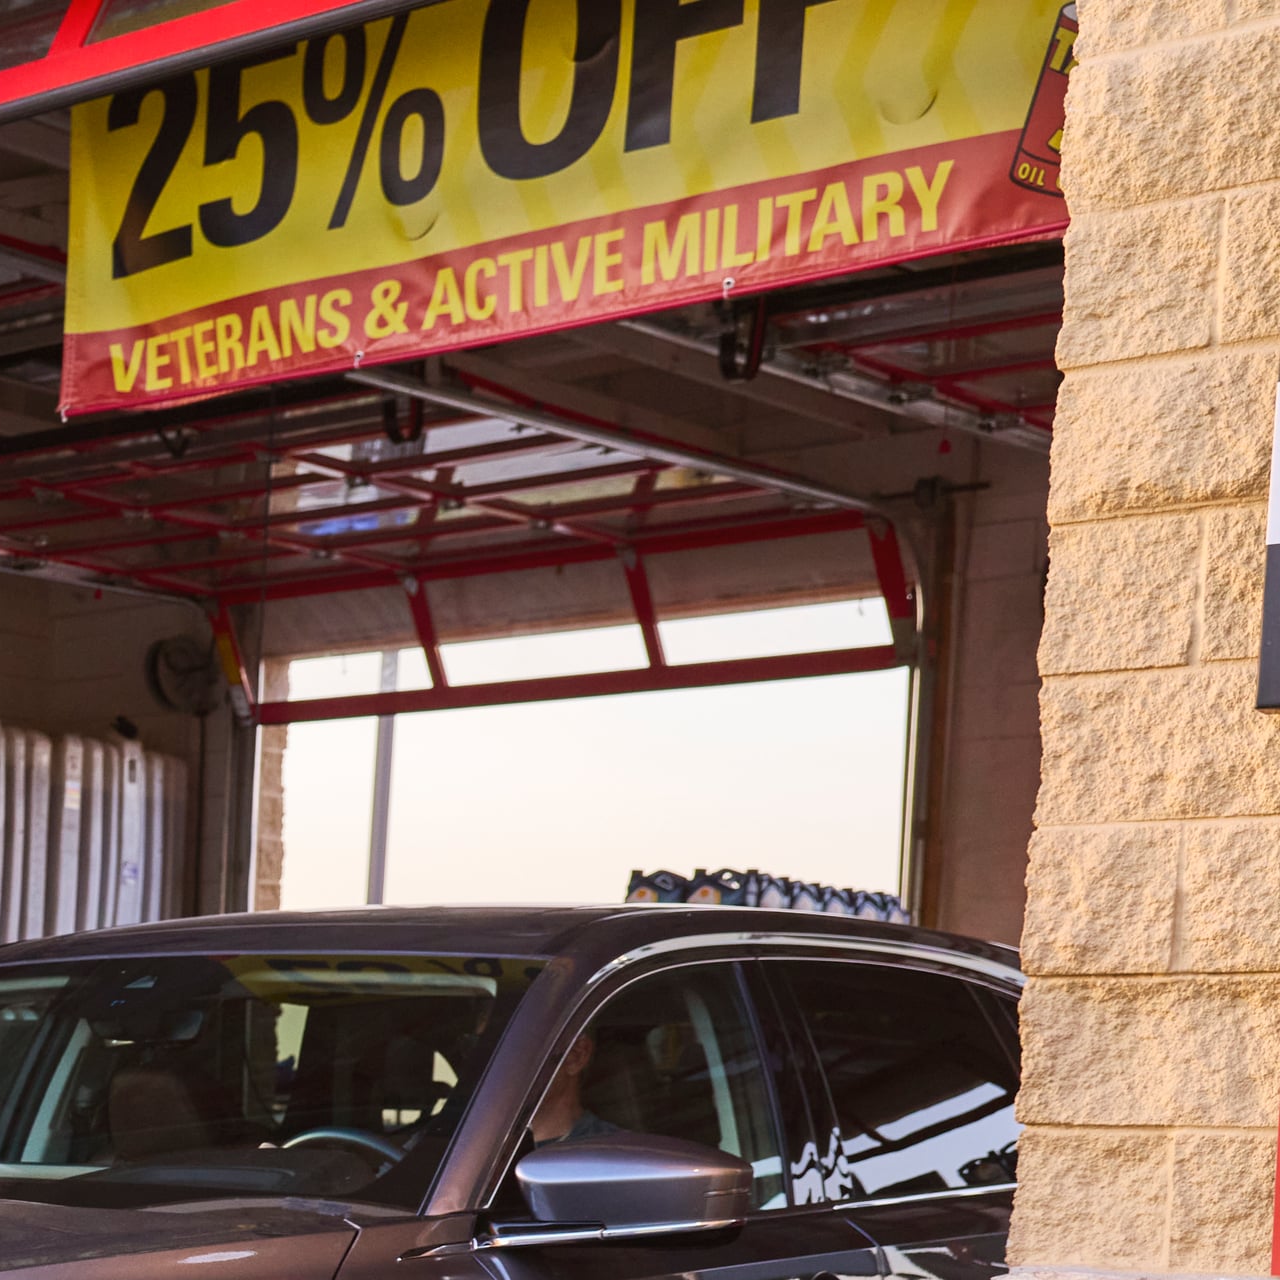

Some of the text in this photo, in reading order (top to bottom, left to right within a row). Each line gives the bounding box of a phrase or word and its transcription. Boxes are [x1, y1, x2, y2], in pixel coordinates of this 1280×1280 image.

[107, 11, 445, 280] 25%
[1018, 162, 1045, 187] OIL
[109, 160, 955, 393] VETERANS & ACTIVE MILITARY
